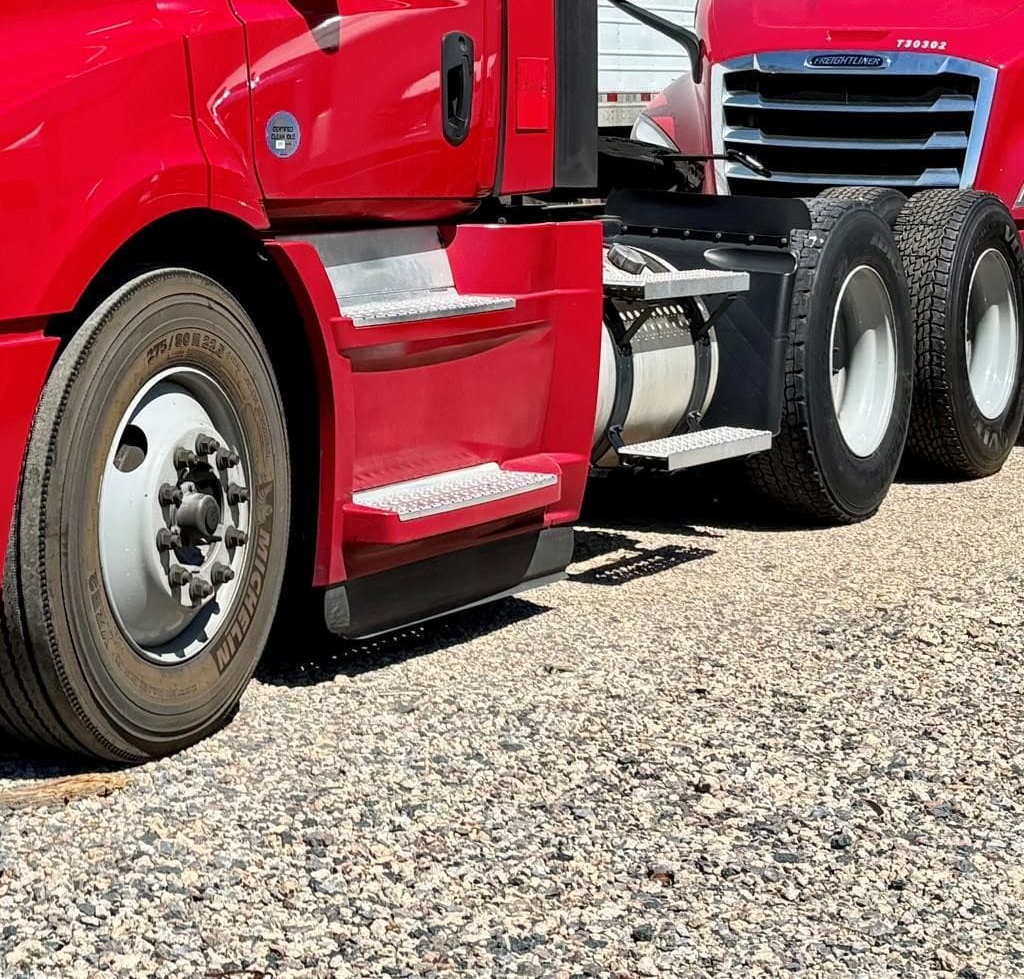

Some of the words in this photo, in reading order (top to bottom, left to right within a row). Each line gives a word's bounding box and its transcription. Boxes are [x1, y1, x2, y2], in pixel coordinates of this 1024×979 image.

[896, 39, 947, 50] T30302
[813, 55, 882, 66] FREIGHTLINER
[214, 528, 272, 675] MICHELIN
